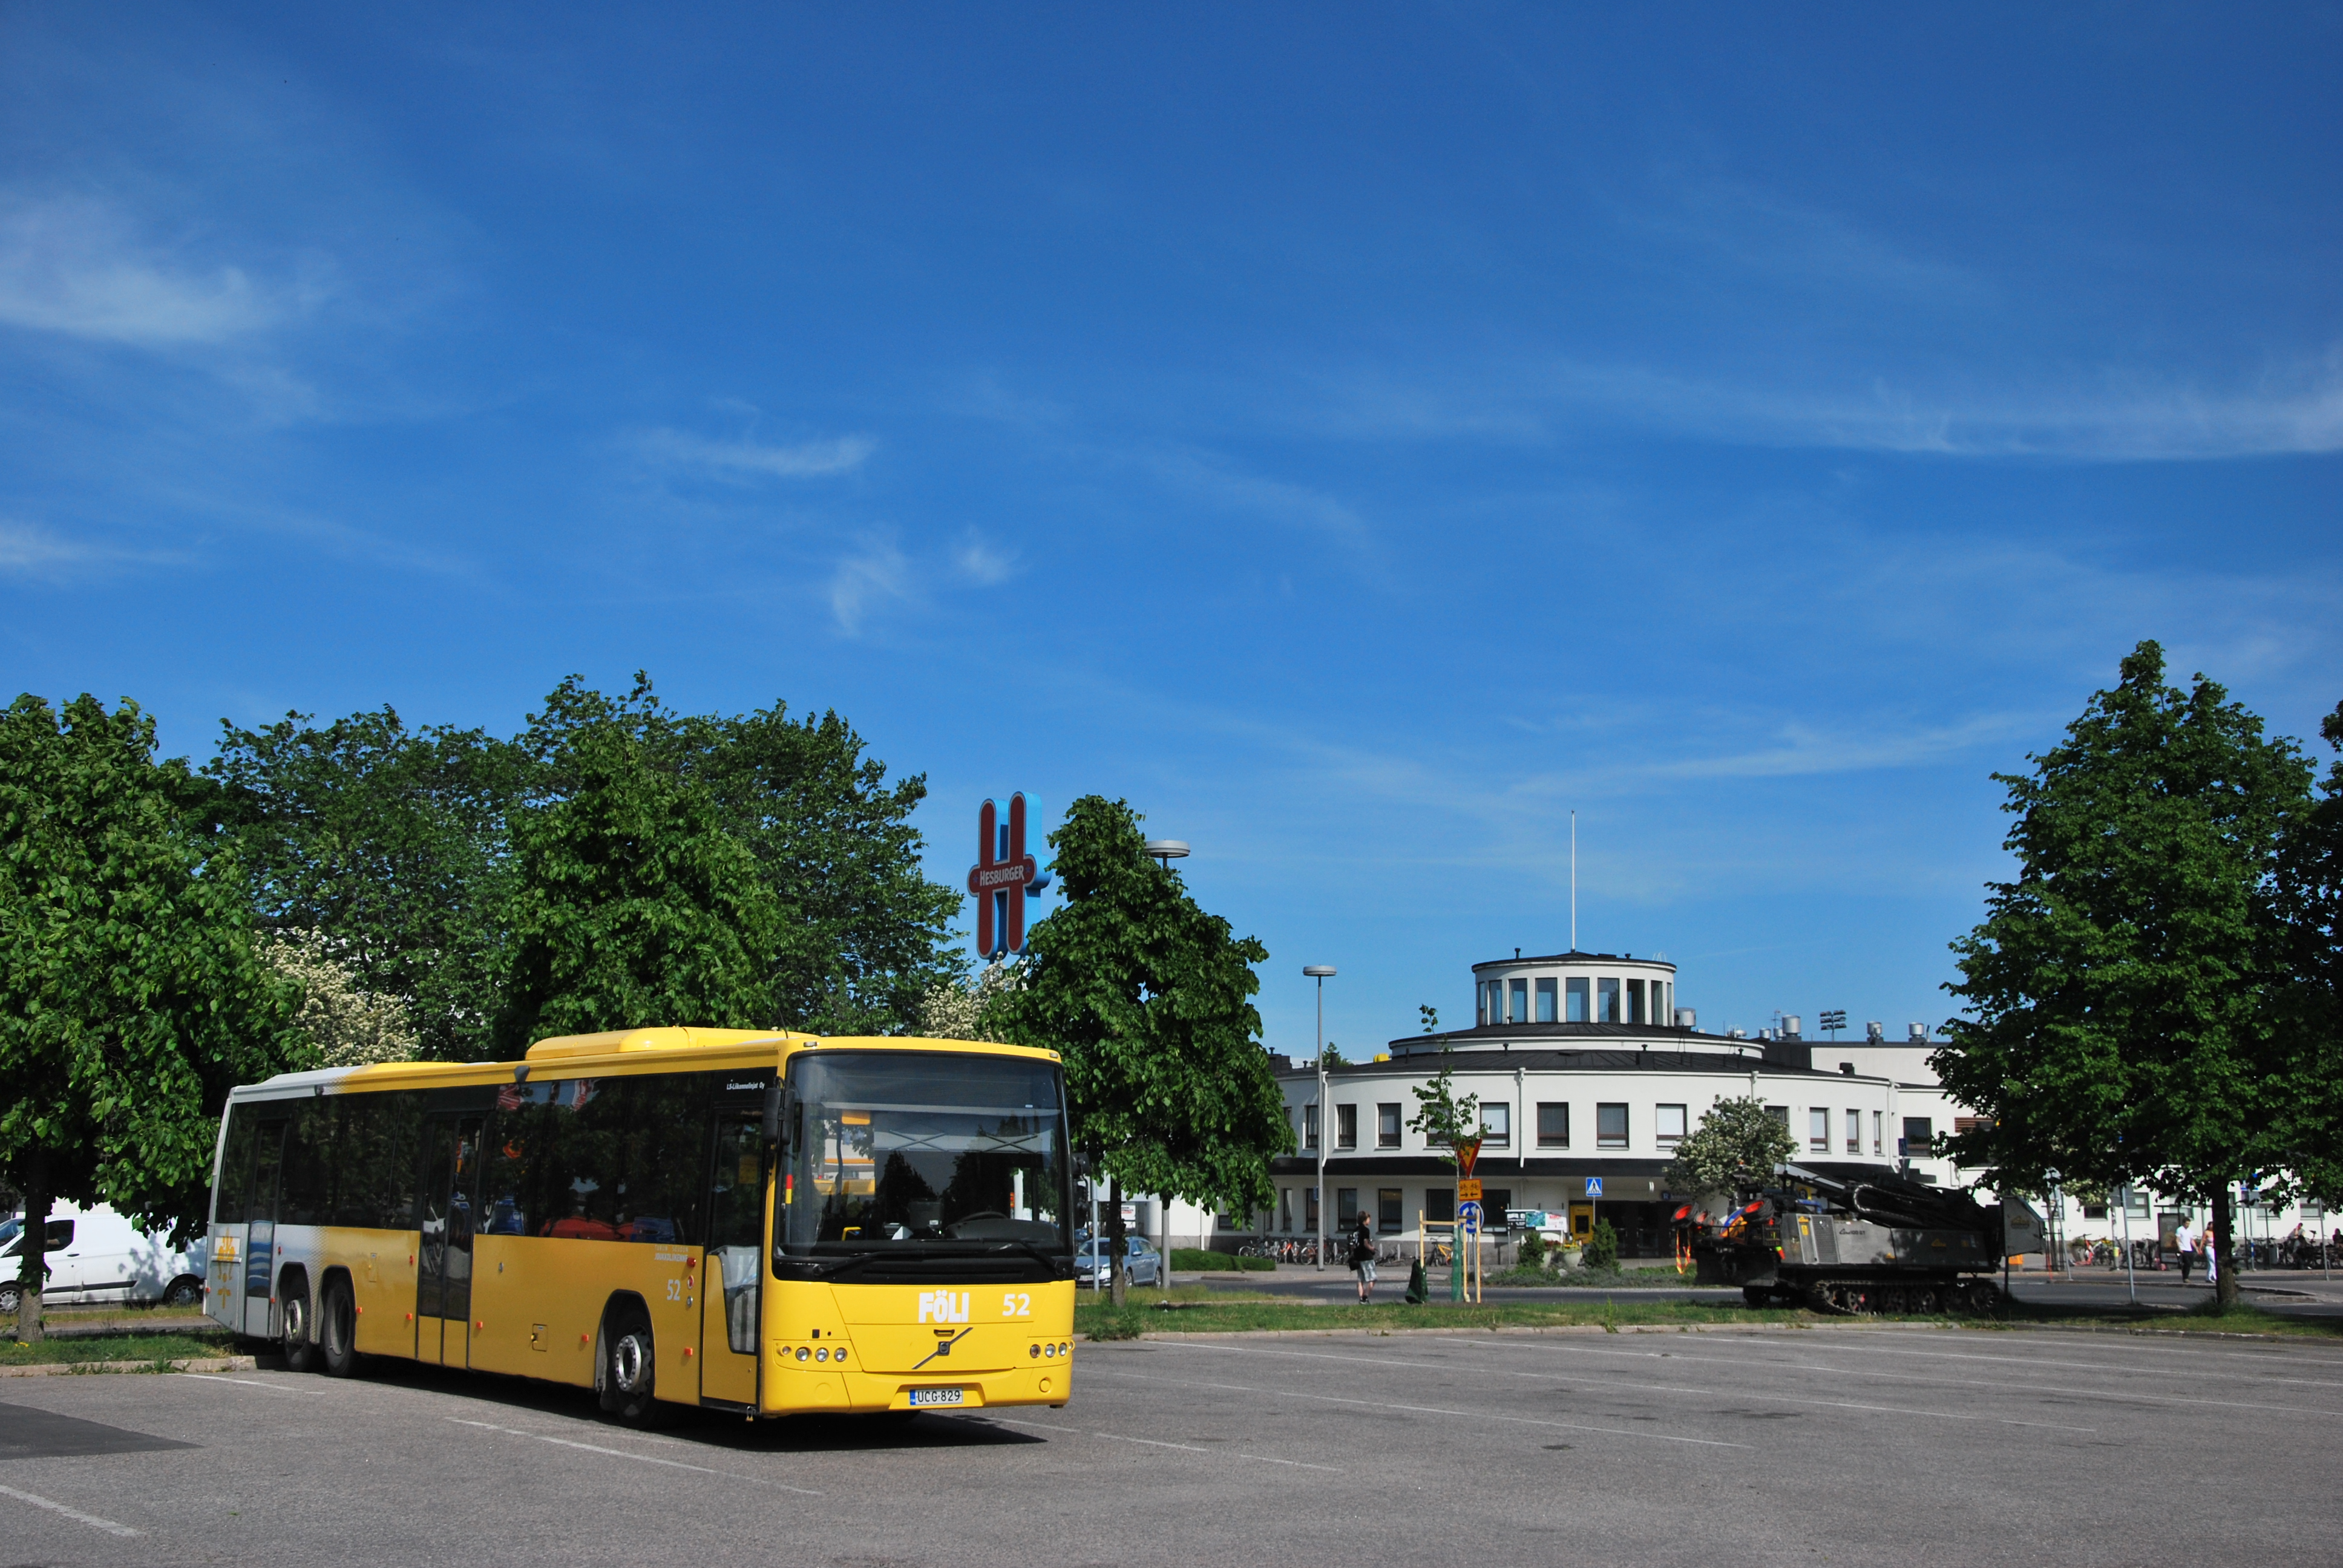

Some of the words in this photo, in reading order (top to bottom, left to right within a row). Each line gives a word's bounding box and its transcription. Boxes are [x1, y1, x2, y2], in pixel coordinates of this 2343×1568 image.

[980, 864, 1024, 887] HESBURGER
[667, 1279, 681, 1301] 52
[918, 1290, 969, 1323] FÖLI
[1002, 1293, 1030, 1316] 52
[917, 1390, 961, 1403] UCG-829
